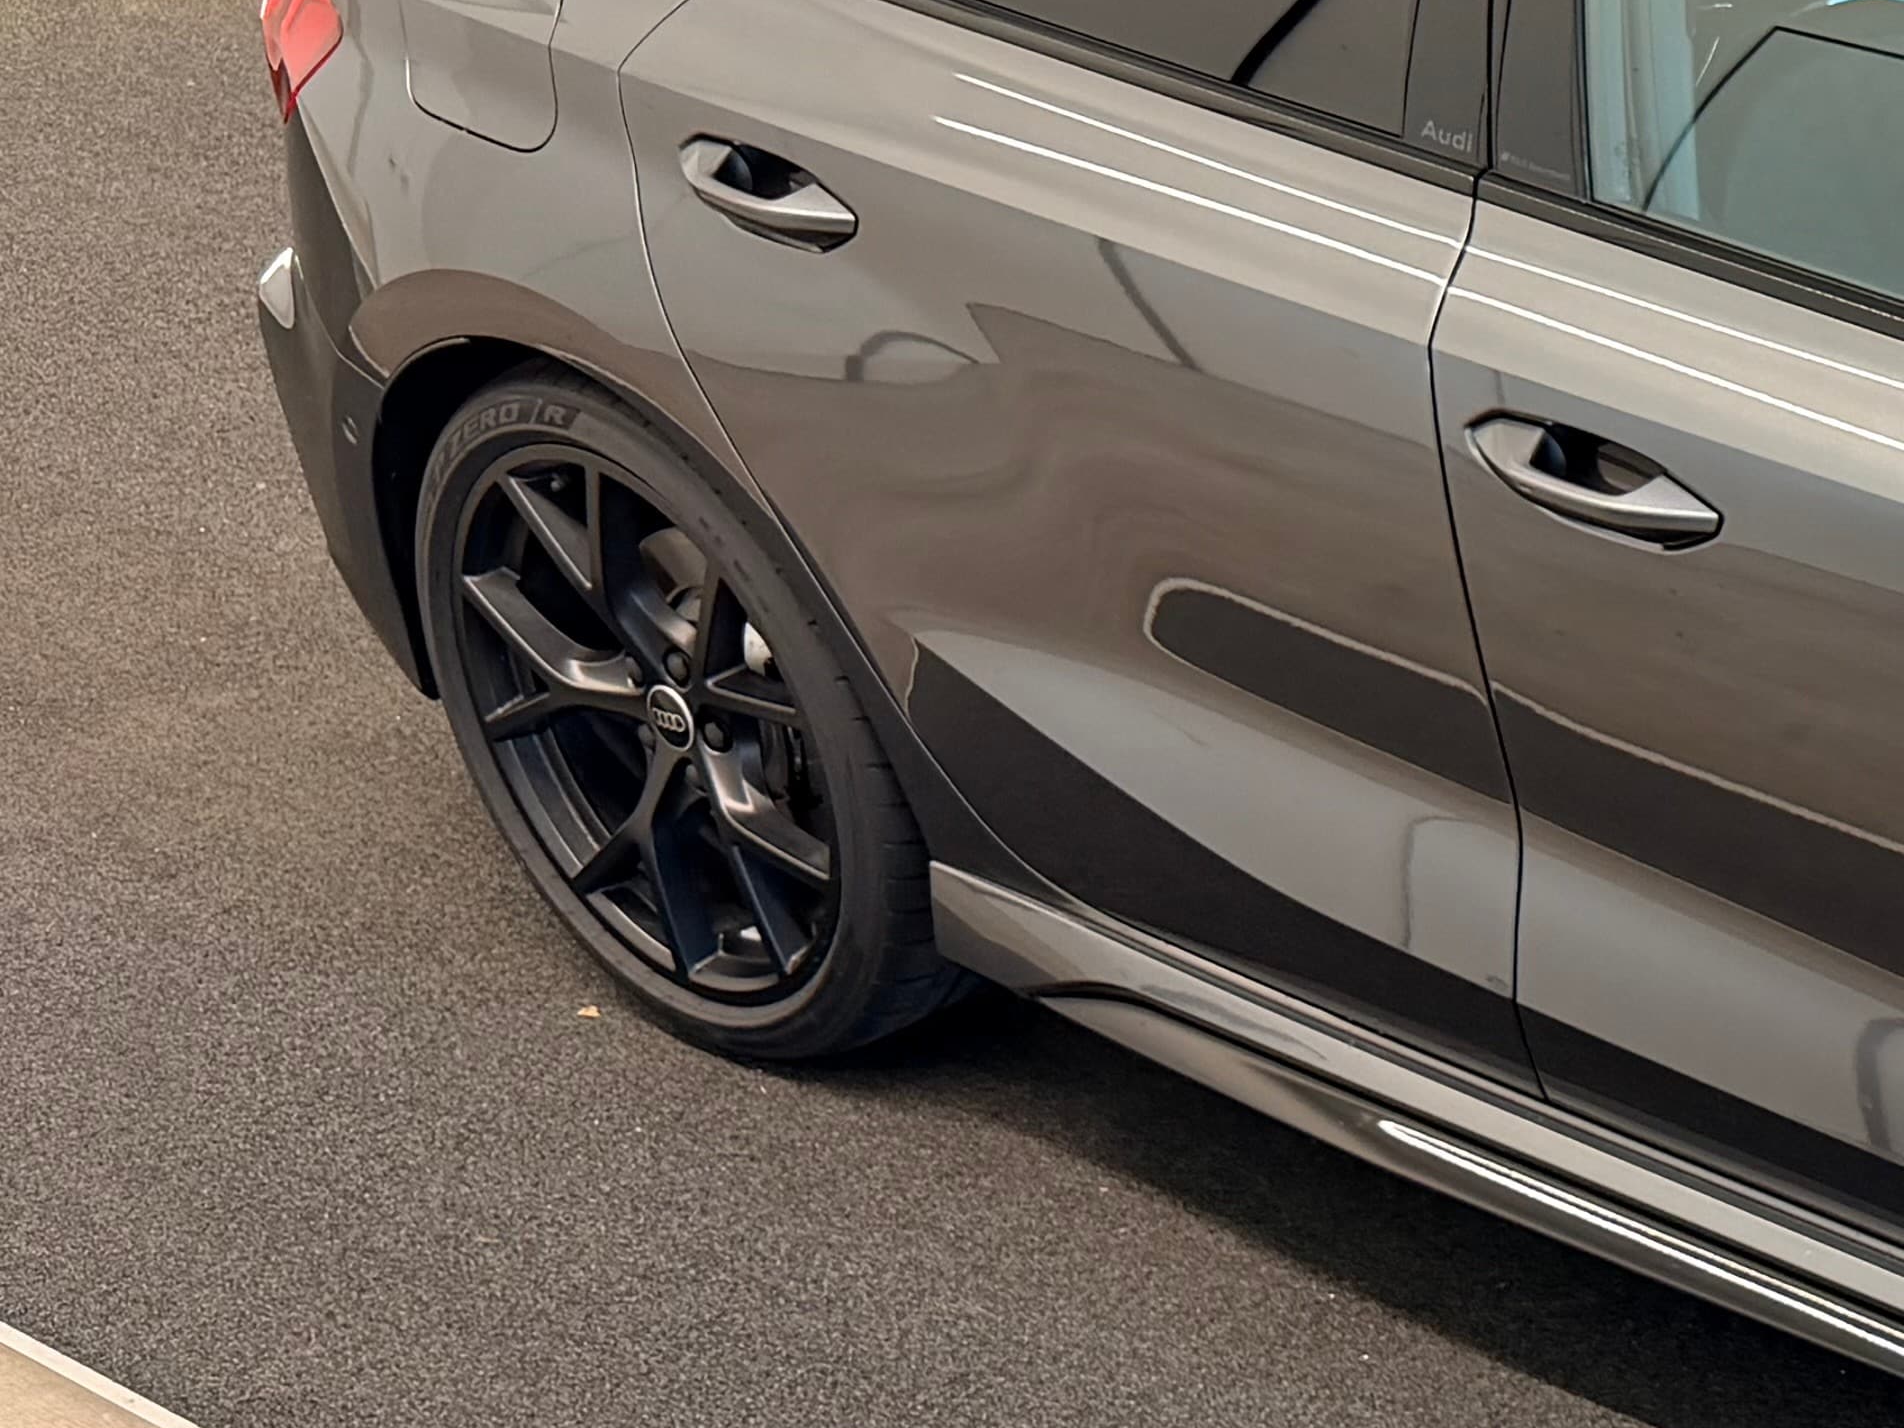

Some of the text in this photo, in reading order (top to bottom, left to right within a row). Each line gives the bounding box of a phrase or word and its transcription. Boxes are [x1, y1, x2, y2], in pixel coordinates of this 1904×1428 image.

[1421, 120, 1473, 153] Audi
[449, 402, 521, 460] ZERO
[543, 404, 567, 425] R
